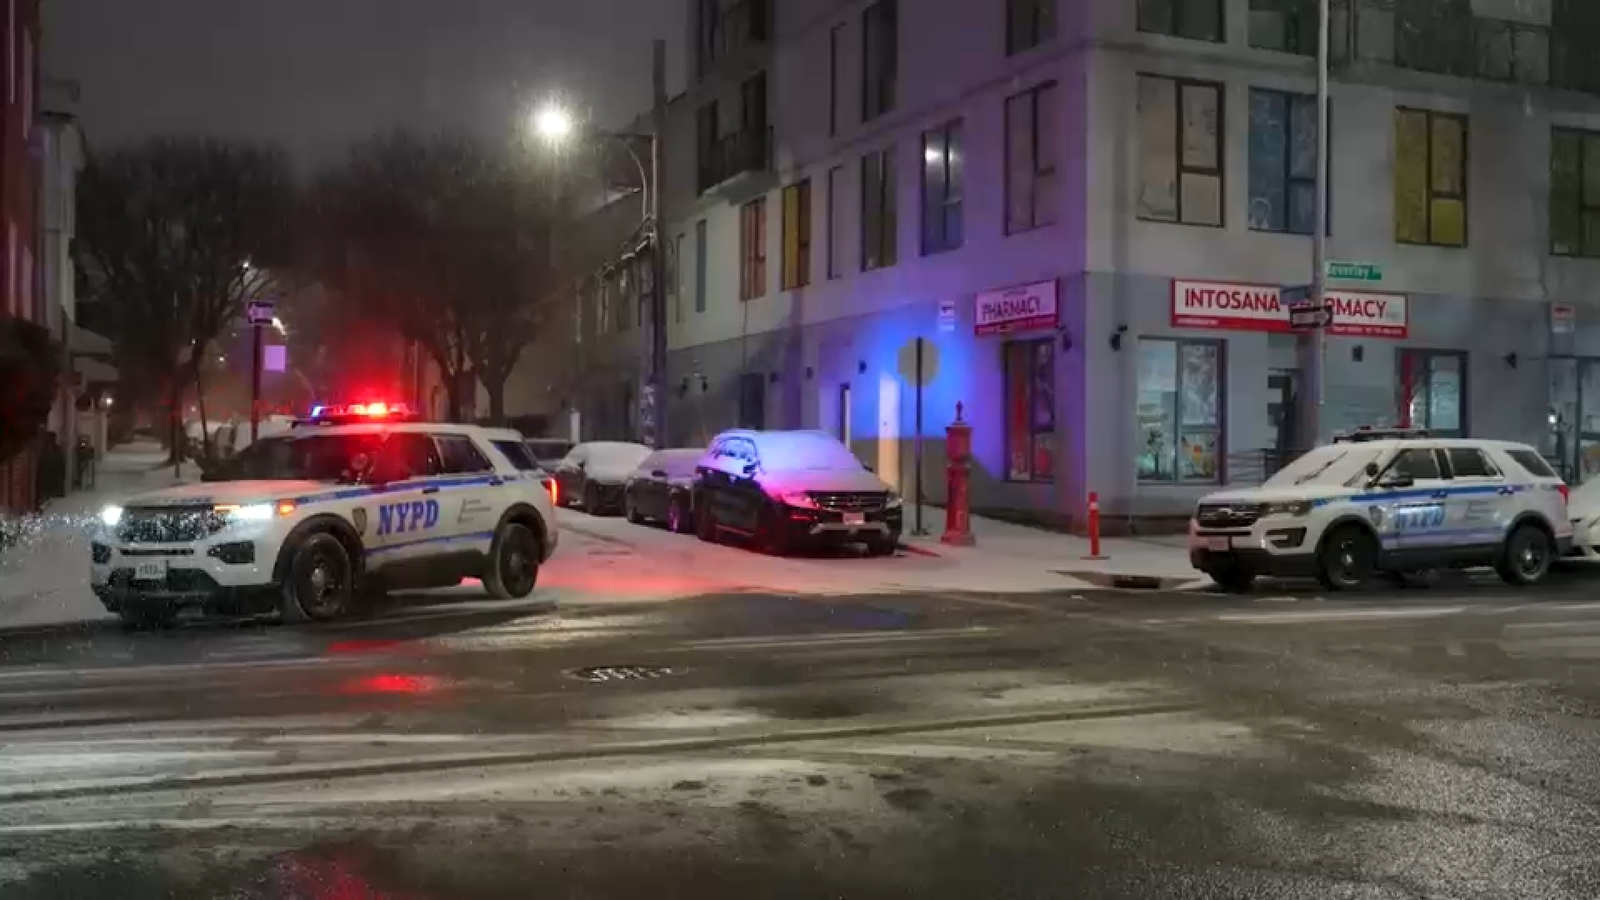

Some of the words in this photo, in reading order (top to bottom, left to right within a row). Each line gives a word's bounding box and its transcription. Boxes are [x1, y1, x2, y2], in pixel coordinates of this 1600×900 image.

[982, 296, 1040, 321] PHARMACY
[1184, 287, 1281, 312] INTOSANA
[1318, 297, 1387, 318] RMACY
[376, 499, 439, 536] NYPD
